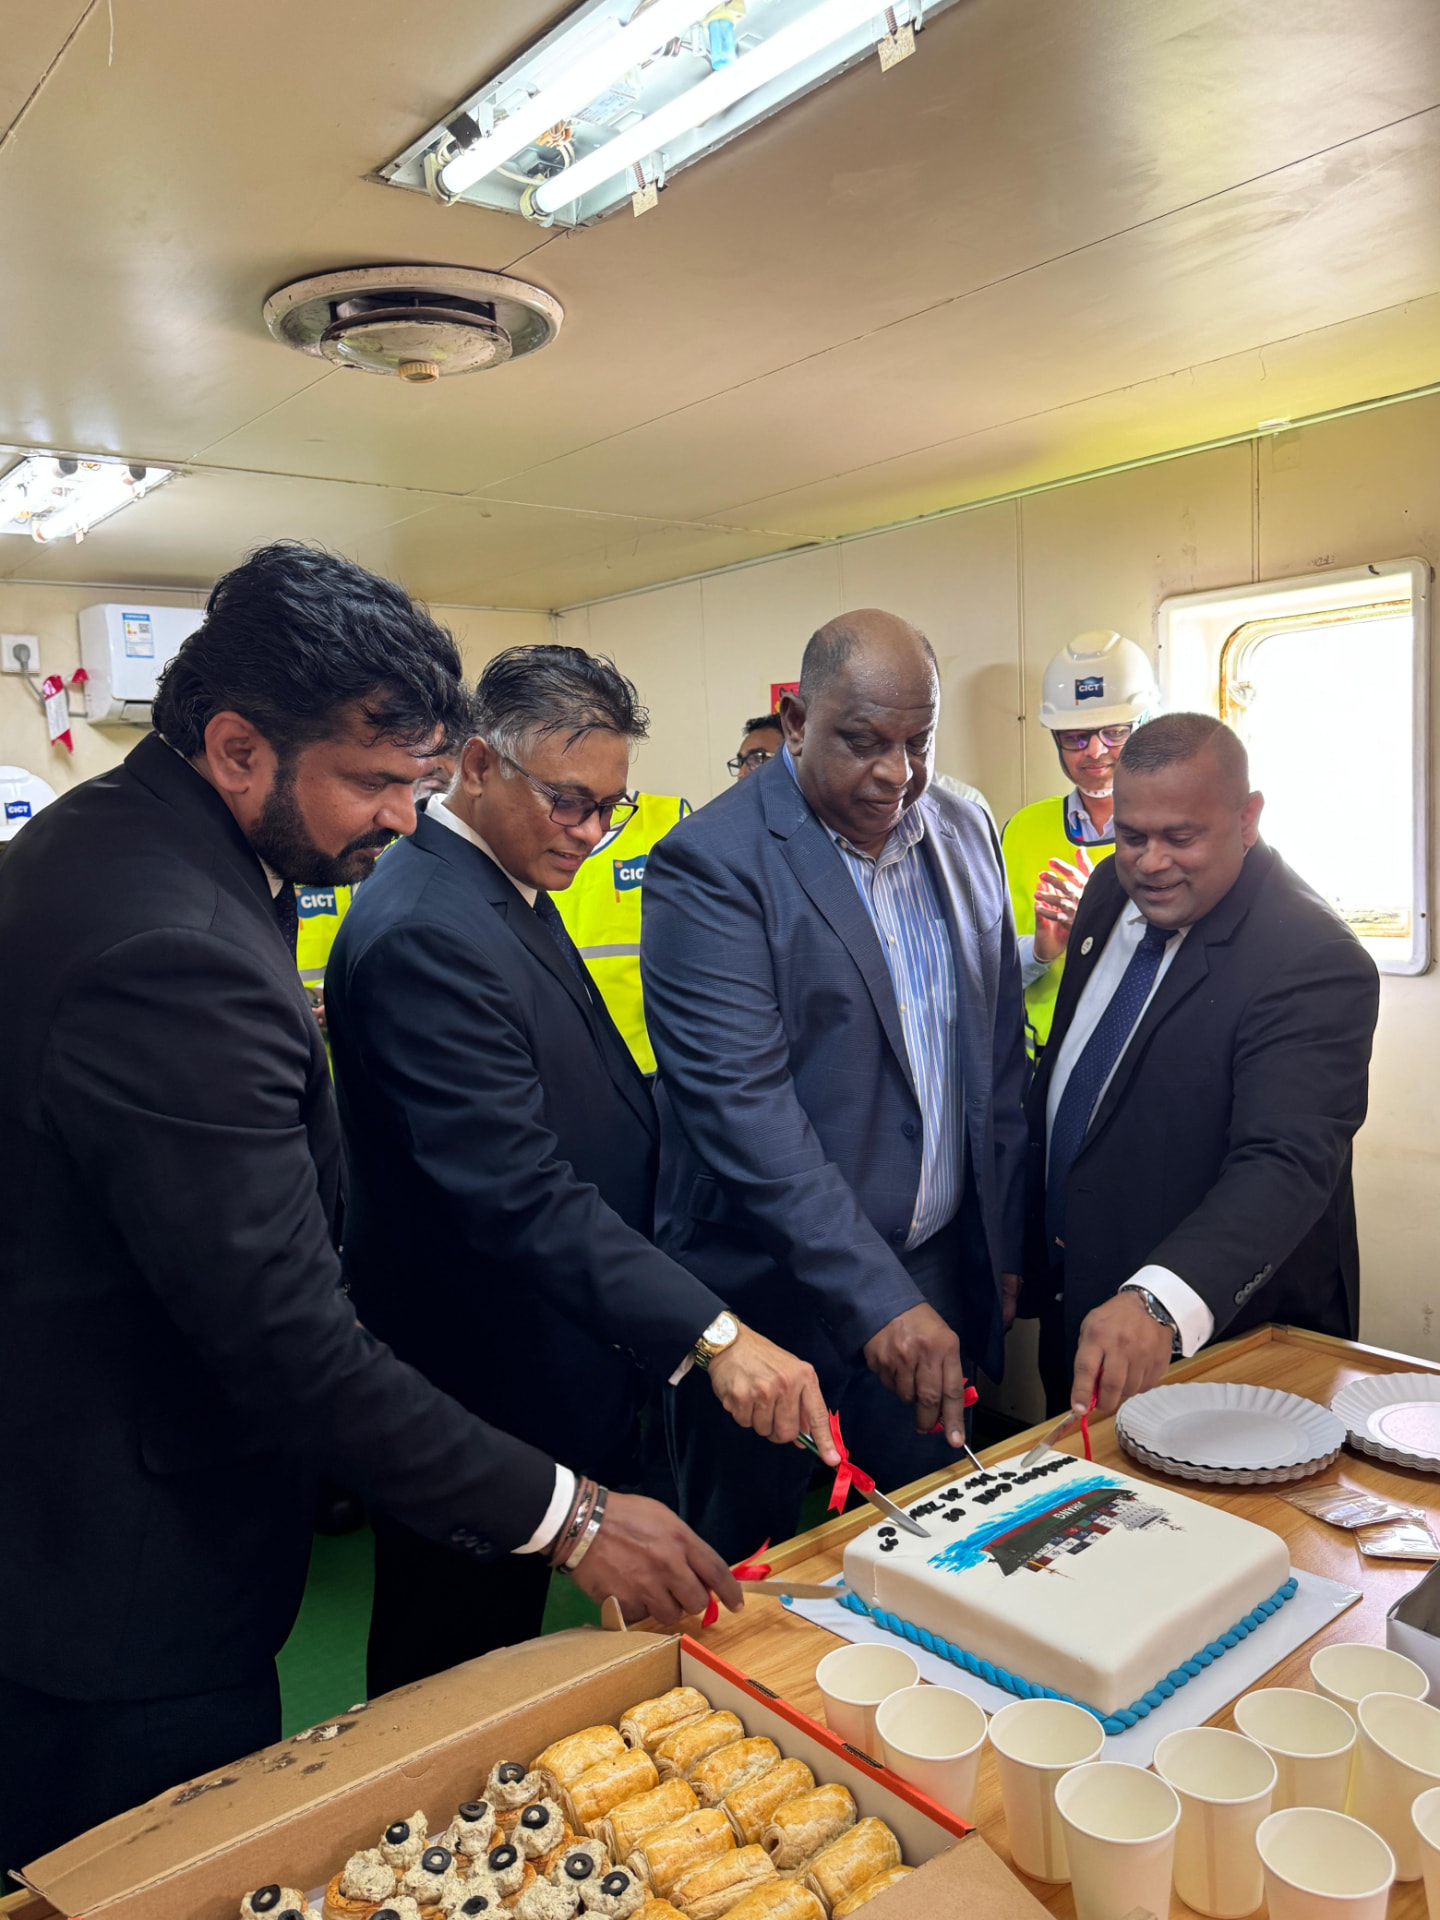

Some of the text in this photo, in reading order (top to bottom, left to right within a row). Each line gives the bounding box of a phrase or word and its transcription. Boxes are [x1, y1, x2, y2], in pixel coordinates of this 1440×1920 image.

[1079, 684, 1100, 692] CICT
[7, 805, 29, 814] CICT
[300, 894, 334, 908] CICT
